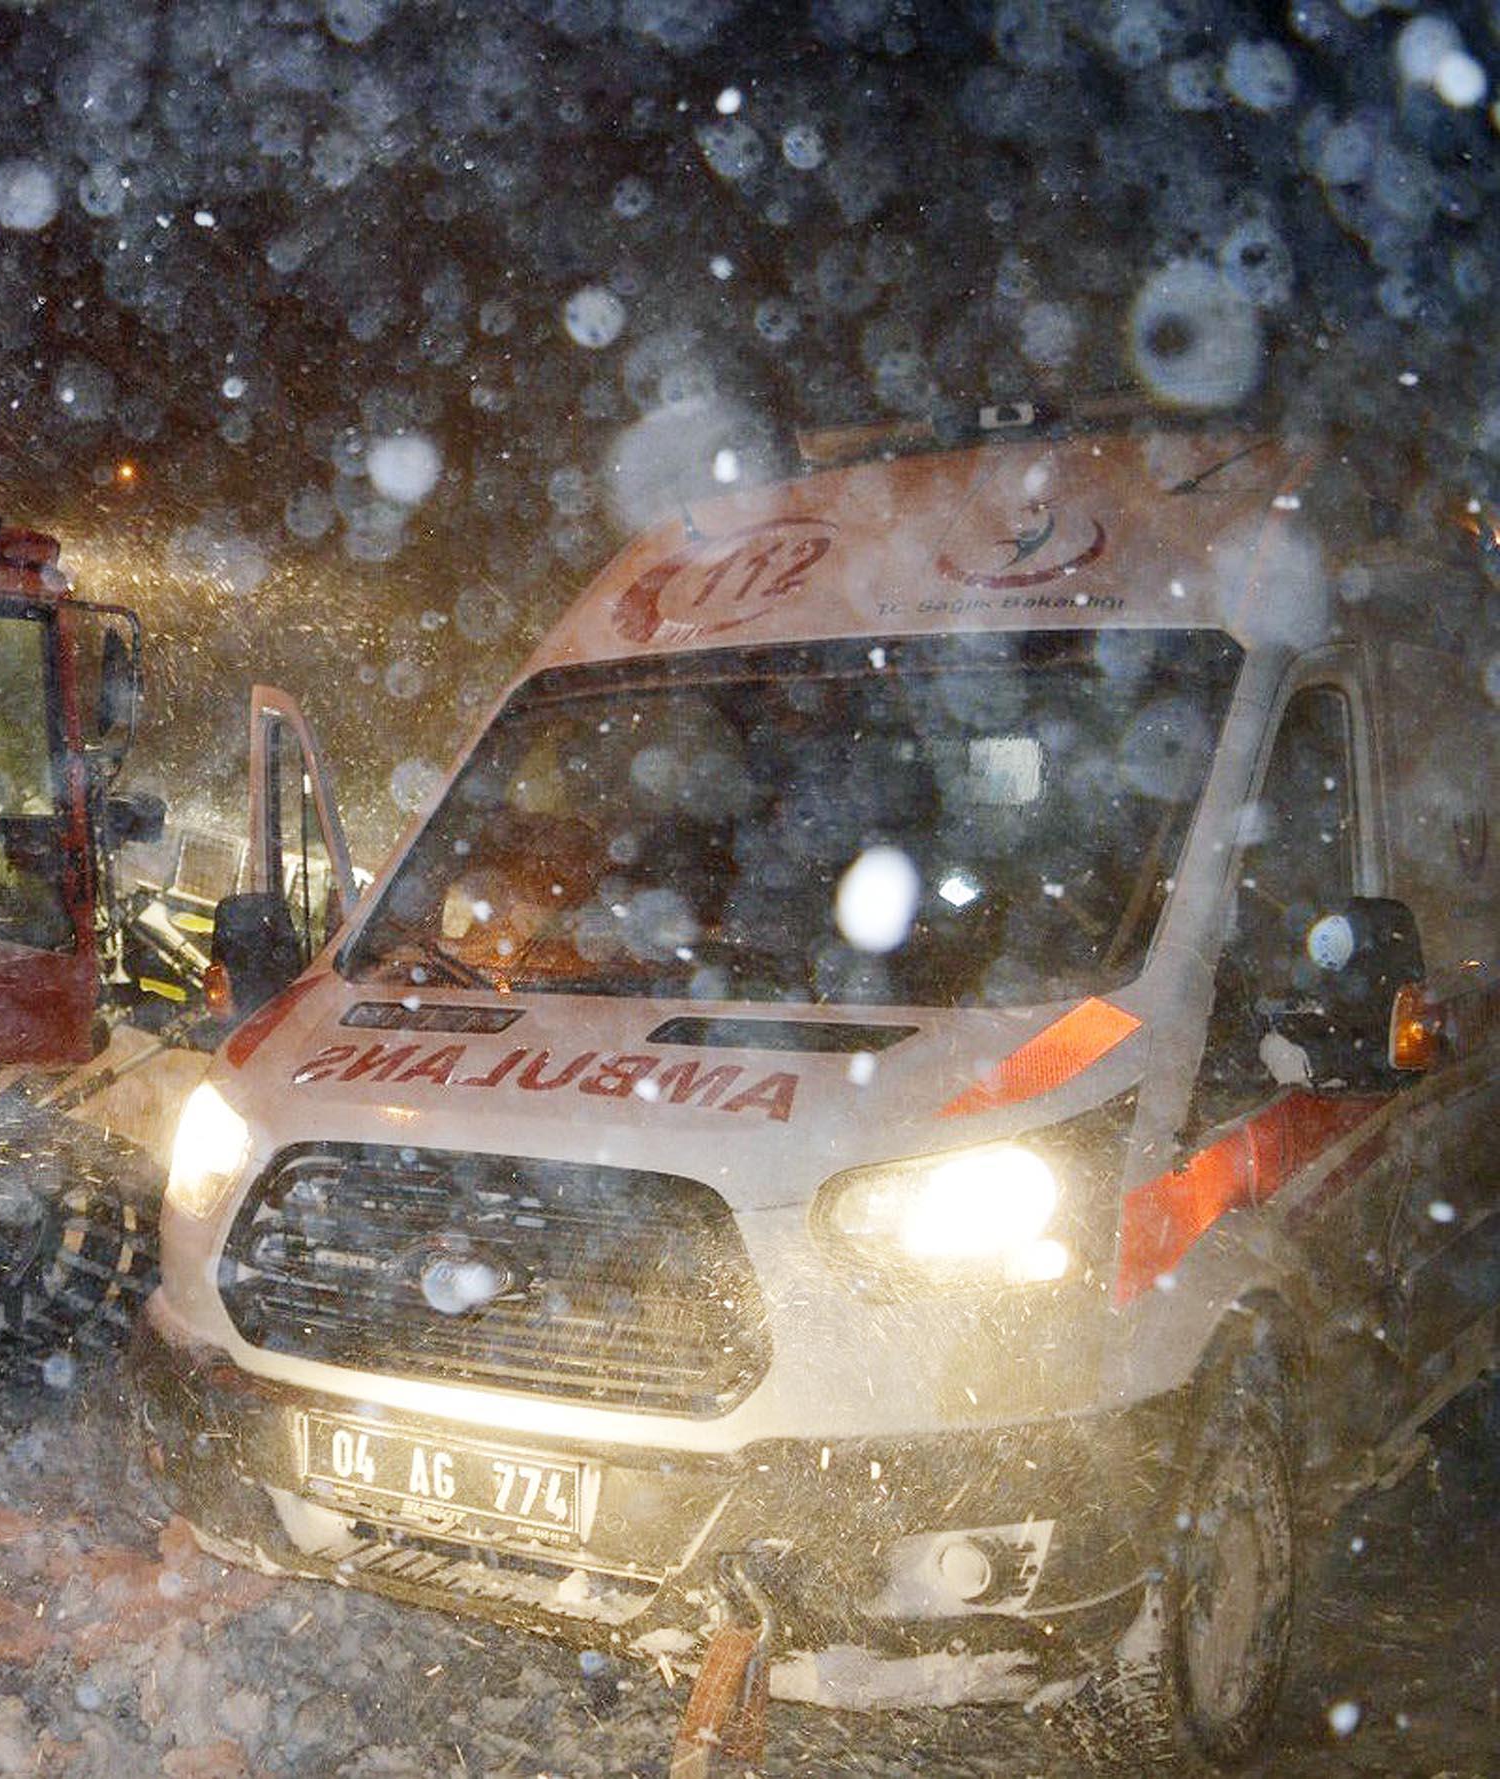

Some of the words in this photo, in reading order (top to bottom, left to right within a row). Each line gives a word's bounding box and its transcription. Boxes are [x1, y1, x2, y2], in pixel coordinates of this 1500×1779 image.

[693, 537, 831, 607] 112
[332, 1429, 376, 1485] 04
[409, 1446, 457, 1501] AG
[491, 1460, 570, 1523] 774
